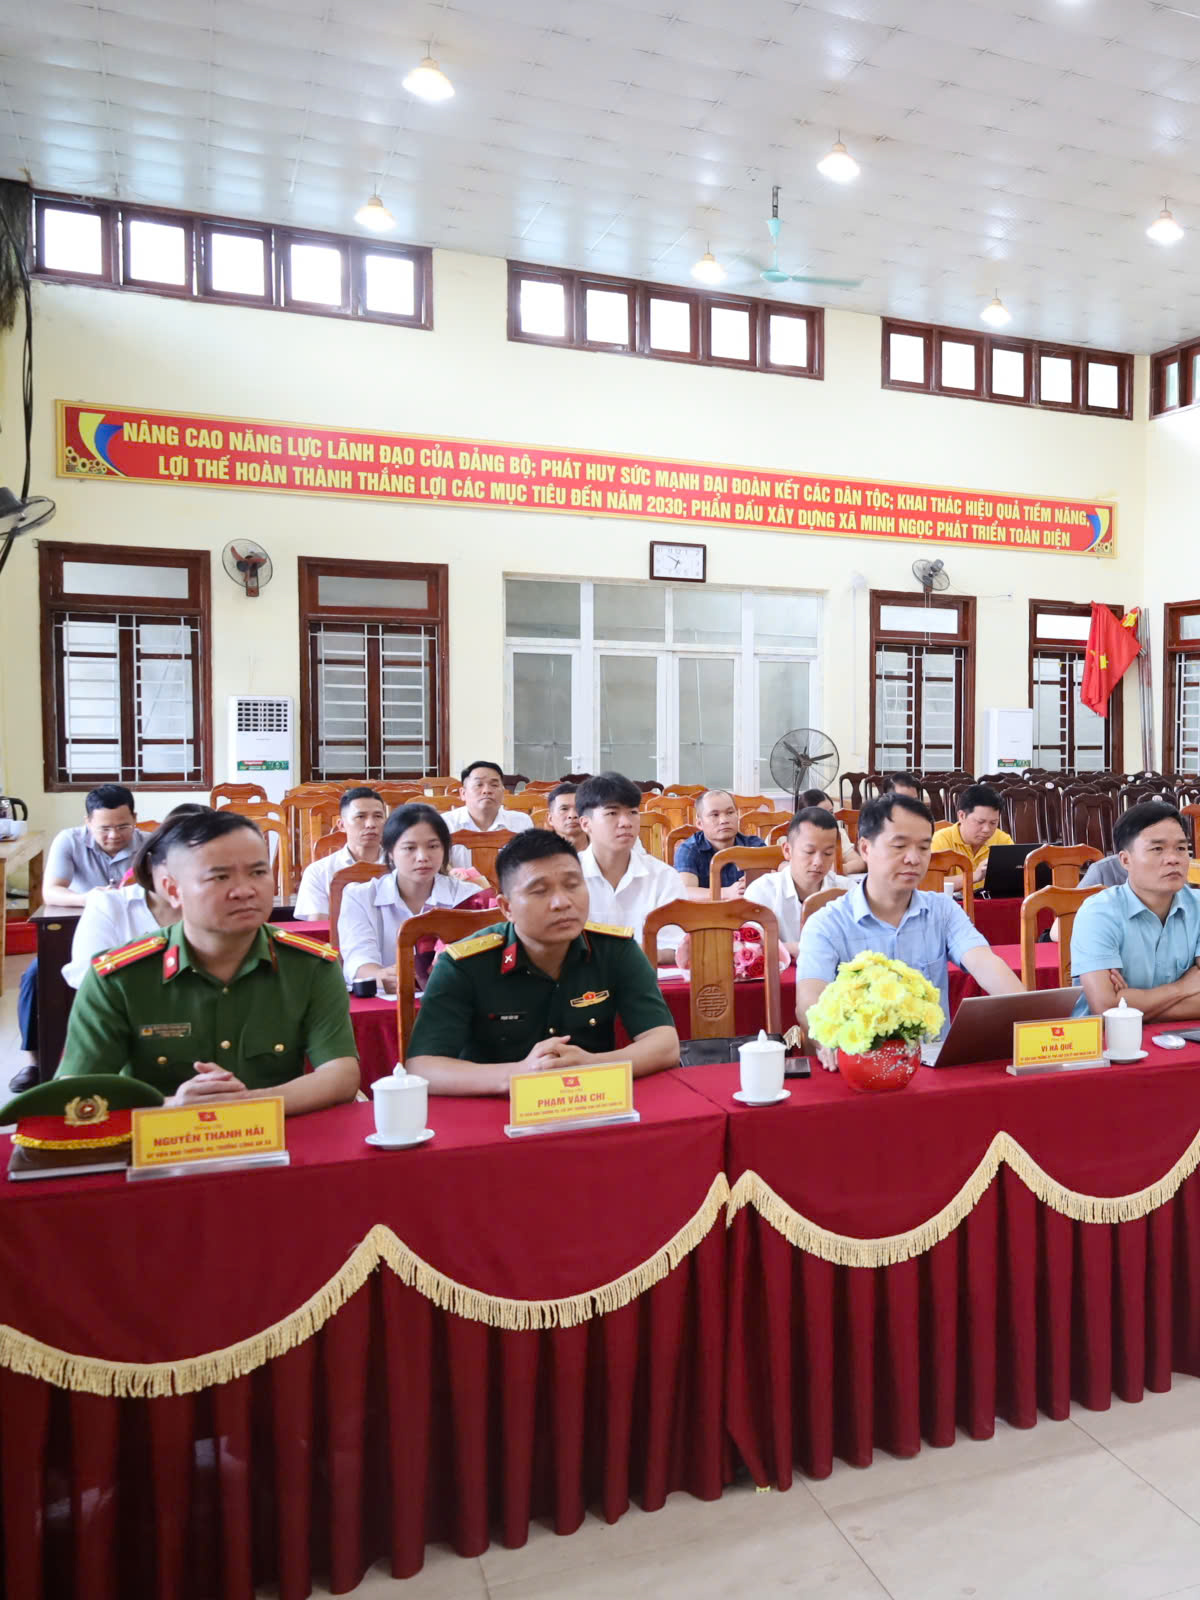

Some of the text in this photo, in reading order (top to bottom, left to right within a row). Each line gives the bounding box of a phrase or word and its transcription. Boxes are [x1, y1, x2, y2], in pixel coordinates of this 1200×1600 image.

[123, 420, 179, 446] NÂNG
[186, 428, 224, 449] CAO
[229, 429, 283, 454] NĂNG
[288, 437, 323, 460] LỰC
[327, 438, 375, 462] LÃNH
[379, 445, 415, 469] ĐẠO
[420, 444, 455, 469] CỦA
[459, 447, 505, 473] ĐẢNG
[509, 454, 536, 479] BỘ;
[541, 457, 582, 479] PHÁT
[586, 463, 616, 482] HUY
[620, 465, 651, 486] SỨC
[655, 470, 700, 492] MẠNH
[704, 475, 728, 496] ĐẠI
[732, 476, 771, 497] ĐOÀN
[775, 479, 800, 500] KẾT
[803, 483, 831, 503] CÁC
[834, 486, 862, 505] DÂN
[865, 488, 895, 510] TỘC;
[897, 494, 928, 511] KHAI
[930, 496, 963, 514] THÁC
[965, 498, 994, 520] HIỆU
[996, 500, 1021, 520] QUẢ
[1054, 506, 1092, 527] NĂNG,
[158, 455, 1072, 551] LỢI THẾ HOÀN THÀNH THẮNG LỢI CÁC MỤC TIÊU ĐẾN NĂM 2030; PHẤN ĐẤU XÂY DỰNG XÃ MINH NGỌC PHÁT TRIỂN TOÀN DIỆN
[153, 1131, 201, 1147] NGUYỄN
[205, 1128, 242, 1141] THANH
